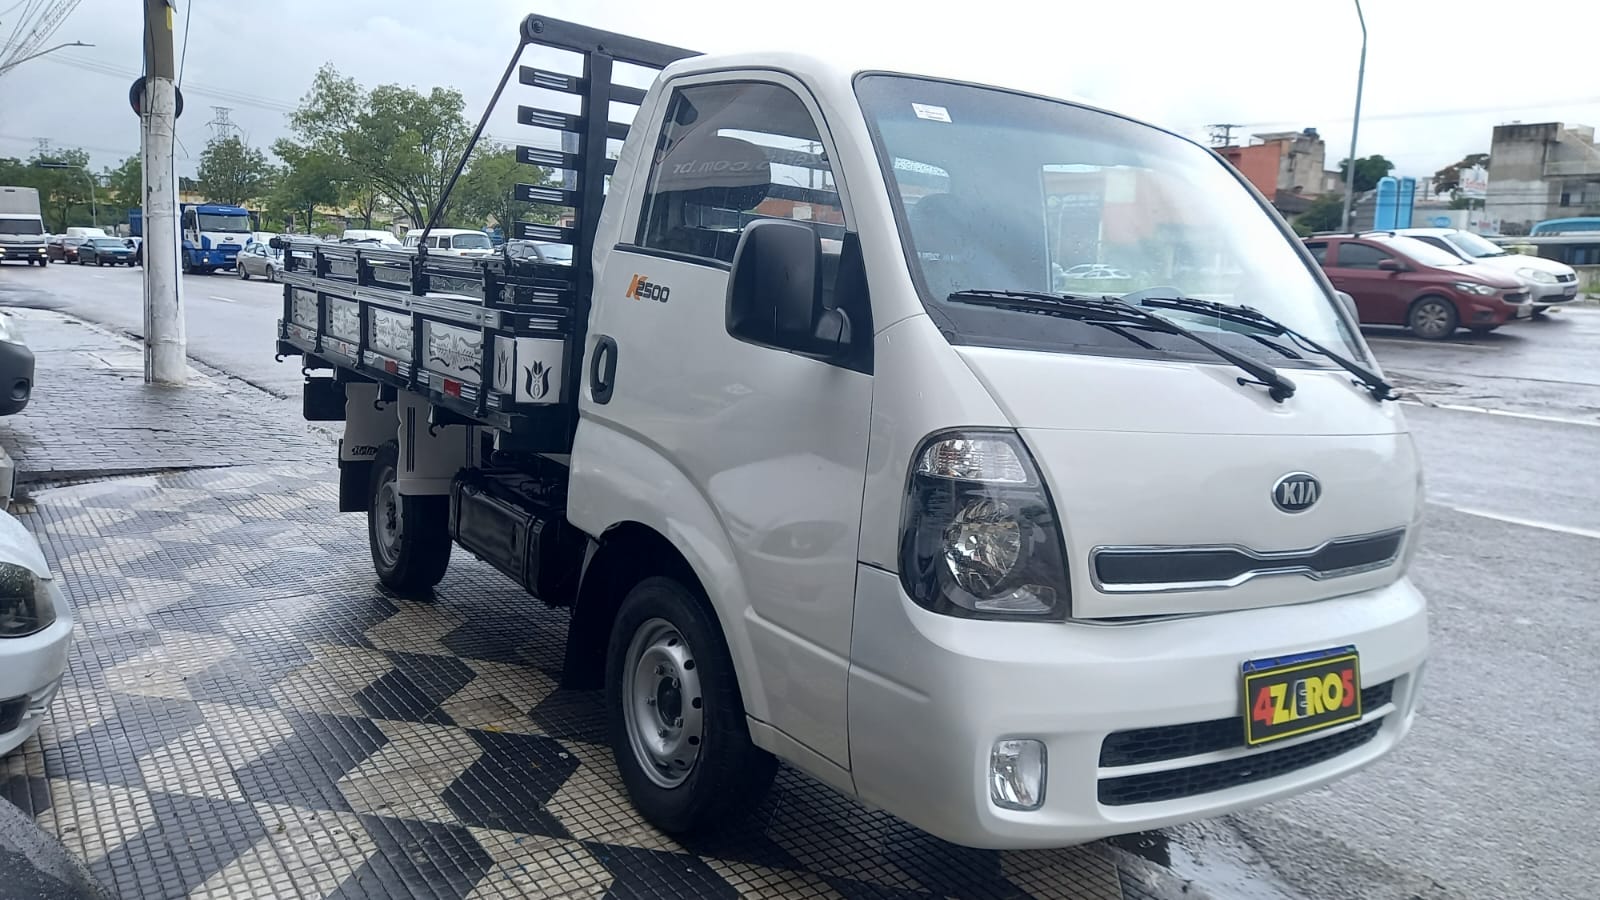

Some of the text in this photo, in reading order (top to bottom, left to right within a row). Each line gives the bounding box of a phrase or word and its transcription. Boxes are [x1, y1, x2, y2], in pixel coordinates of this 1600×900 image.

[625, 273, 670, 303] K2500
[1282, 481, 1317, 505] KIA
[1253, 668, 1355, 727] 4ZERO5
